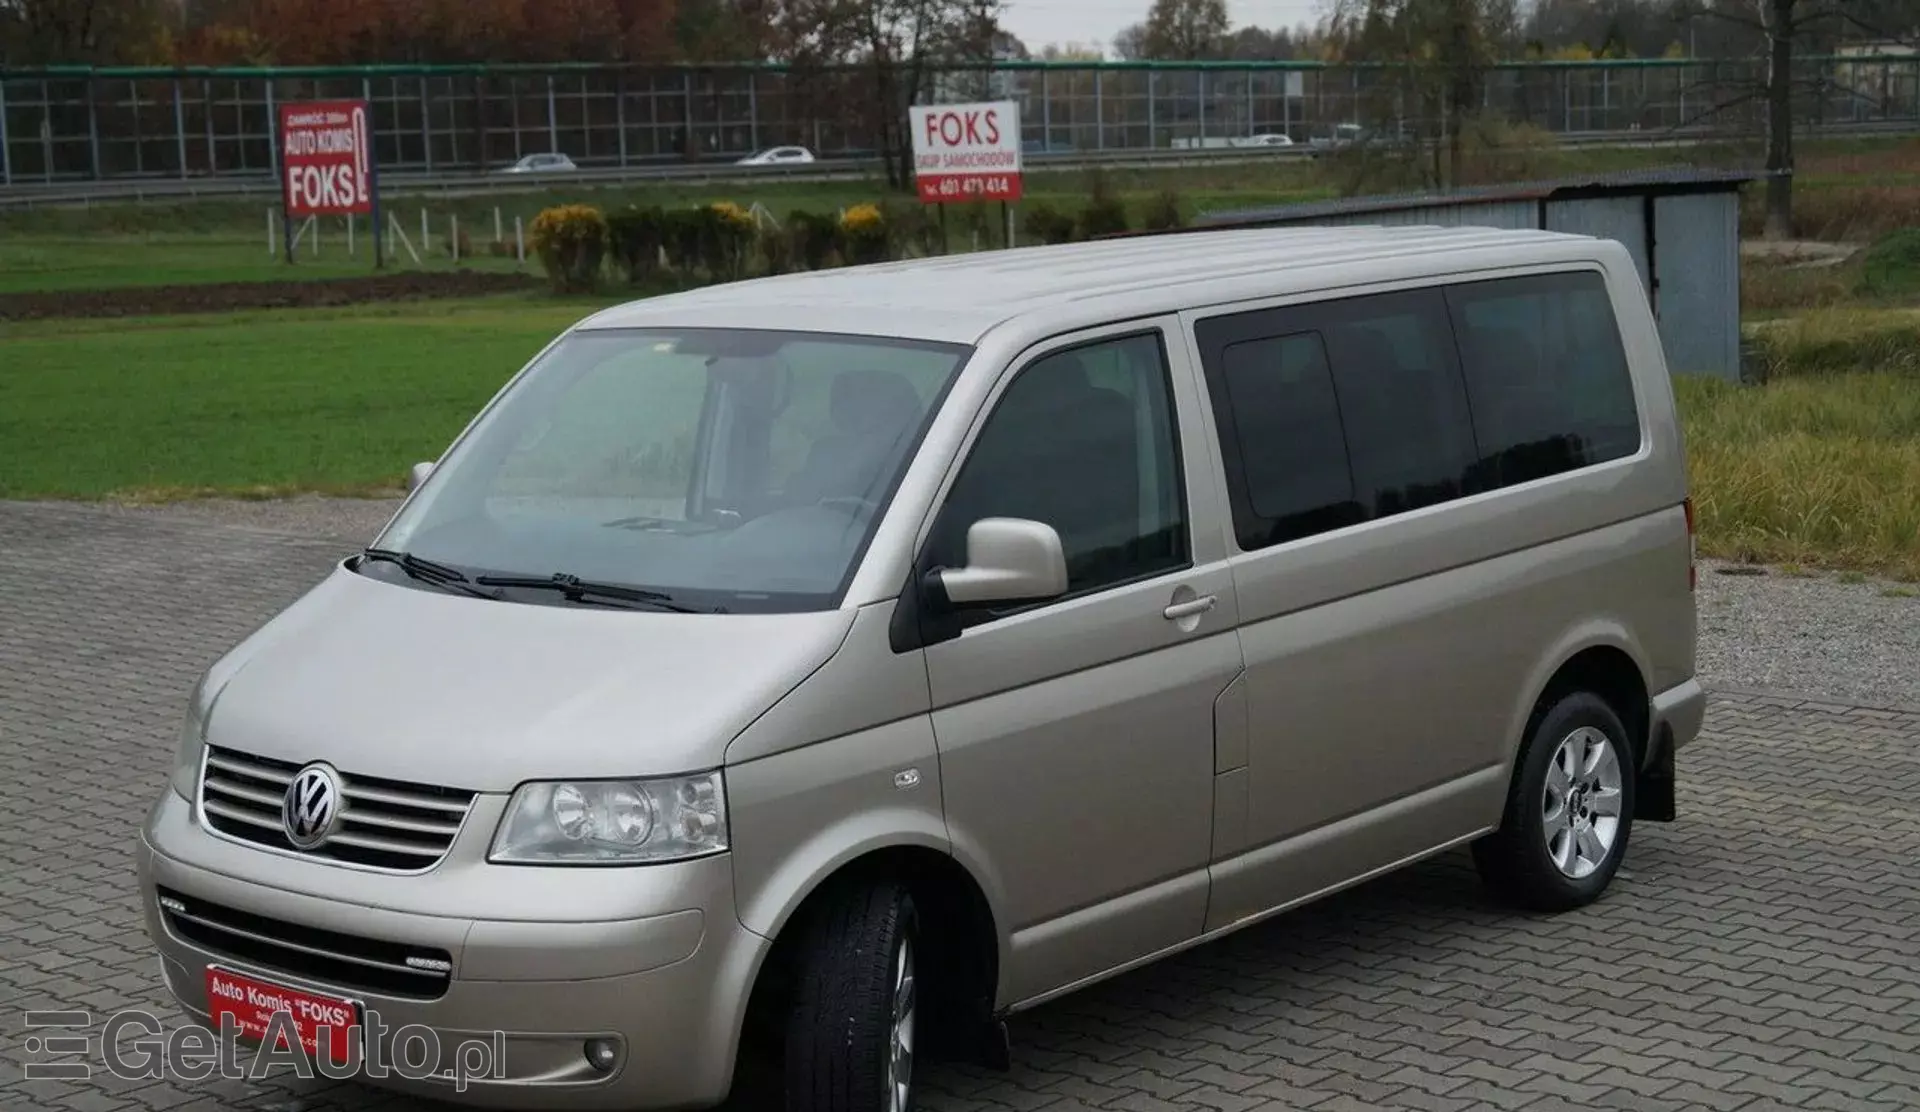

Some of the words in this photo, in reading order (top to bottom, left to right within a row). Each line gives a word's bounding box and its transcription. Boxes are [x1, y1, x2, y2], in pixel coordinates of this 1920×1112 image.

[286, 130, 317, 156] AUTO
[317, 128, 353, 155] KOMIS
[925, 109, 999, 147] FOKS
[943, 150, 1016, 168] SAMOCHODÓW
[289, 164, 355, 208] FOKS
[212, 976, 244, 1001] Auto
[247, 986, 293, 1013] Komis
